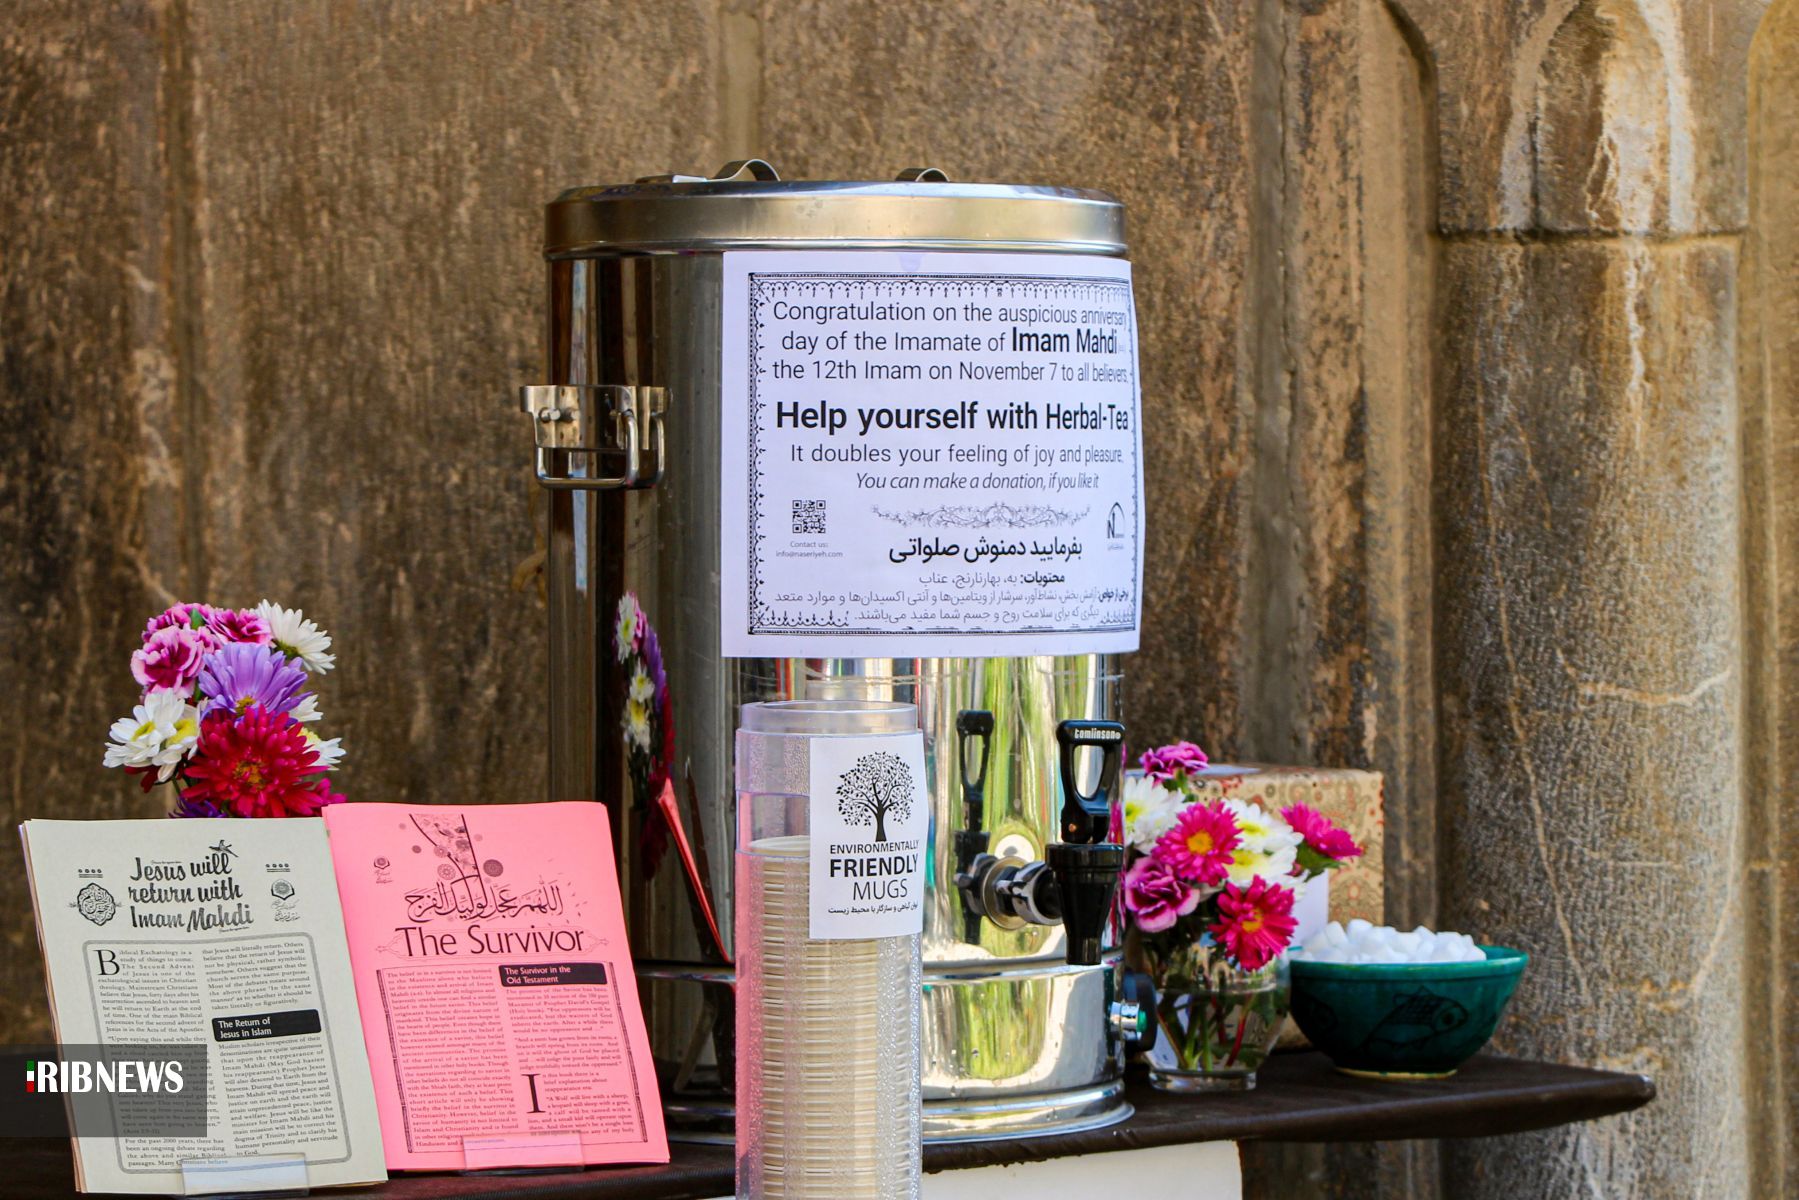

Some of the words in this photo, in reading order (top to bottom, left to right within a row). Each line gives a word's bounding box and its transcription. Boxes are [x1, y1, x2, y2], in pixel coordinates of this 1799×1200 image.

[773, 301, 925, 325] Congratulation
[933, 306, 956, 321] on
[964, 303, 992, 321] the
[998, 306, 1077, 326] auspicious
[782, 332, 818, 355] day
[826, 332, 847, 351] of
[855, 332, 887, 351] the
[895, 332, 981, 351] Imamate
[988, 332, 1006, 351] of
[1012, 327, 1070, 352] Imam
[1076, 329, 1118, 354] Mahdi
[773, 361, 805, 379] the
[813, 360, 856, 379] 12th
[865, 361, 921, 379] Imam
[929, 365, 953, 379] on
[960, 361, 1044, 381] November
[1050, 363, 1057, 380] 7
[1062, 365, 1074, 382] to
[1078, 365, 1090, 382] all
[777, 401, 846, 435] Help
[859, 401, 978, 435] yourself
[987, 402, 1038, 429] with
[1046, 403, 1128, 430] Herbal-Tea
[792, 445, 804, 462] It
[812, 444, 891, 462] doubles
[900, 448, 940, 467] your
[948, 445, 1007, 467] feeling
[1014, 445, 1030, 462] of
[1034, 445, 1055, 467] joy
[1060, 445, 1081, 462] and
[857, 473, 887, 489] You
[891, 476, 920, 489] can
[924, 473, 967, 489] make
[969, 476, 978, 489] a
[982, 473, 1046, 491] donation,
[1048, 472, 1057, 493] if
[1057, 476, 1076, 493] you
[1078, 473, 1091, 488] like
[1093, 474, 1099, 488] it
[889, 538, 960, 563] صلواتی
[965, 535, 1026, 561] دمنوش
[1031, 536, 1083, 561] بفرمایید
[1020, 571, 1065, 587] محتویات:
[830, 839, 919, 854] ENVIRONMENTALLY
[130, 857, 186, 881] Jesus
[190, 853, 232, 877] will
[830, 853, 919, 877] FRIENDLY
[128, 882, 194, 903] return
[198, 877, 242, 902] with
[853, 878, 908, 900] MUGS
[130, 906, 185, 928] Imam
[187, 903, 254, 932] Mahdi
[395, 926, 457, 956] The
[468, 925, 584, 954] Survivor
[505, 967, 519, 975] The
[521, 966, 548, 975] Survivor
[558, 965, 570, 973] the
[507, 976, 520, 984] Old
[522, 975, 558, 984] Testament
[218, 1020, 234, 1028] The
[236, 1018, 260, 1027] Return
[262, 1016, 271, 1025] of
[219, 1029, 240, 1039] Jesus
[242, 1028, 250, 1036] in
[252, 1027, 272, 1035] Islam
